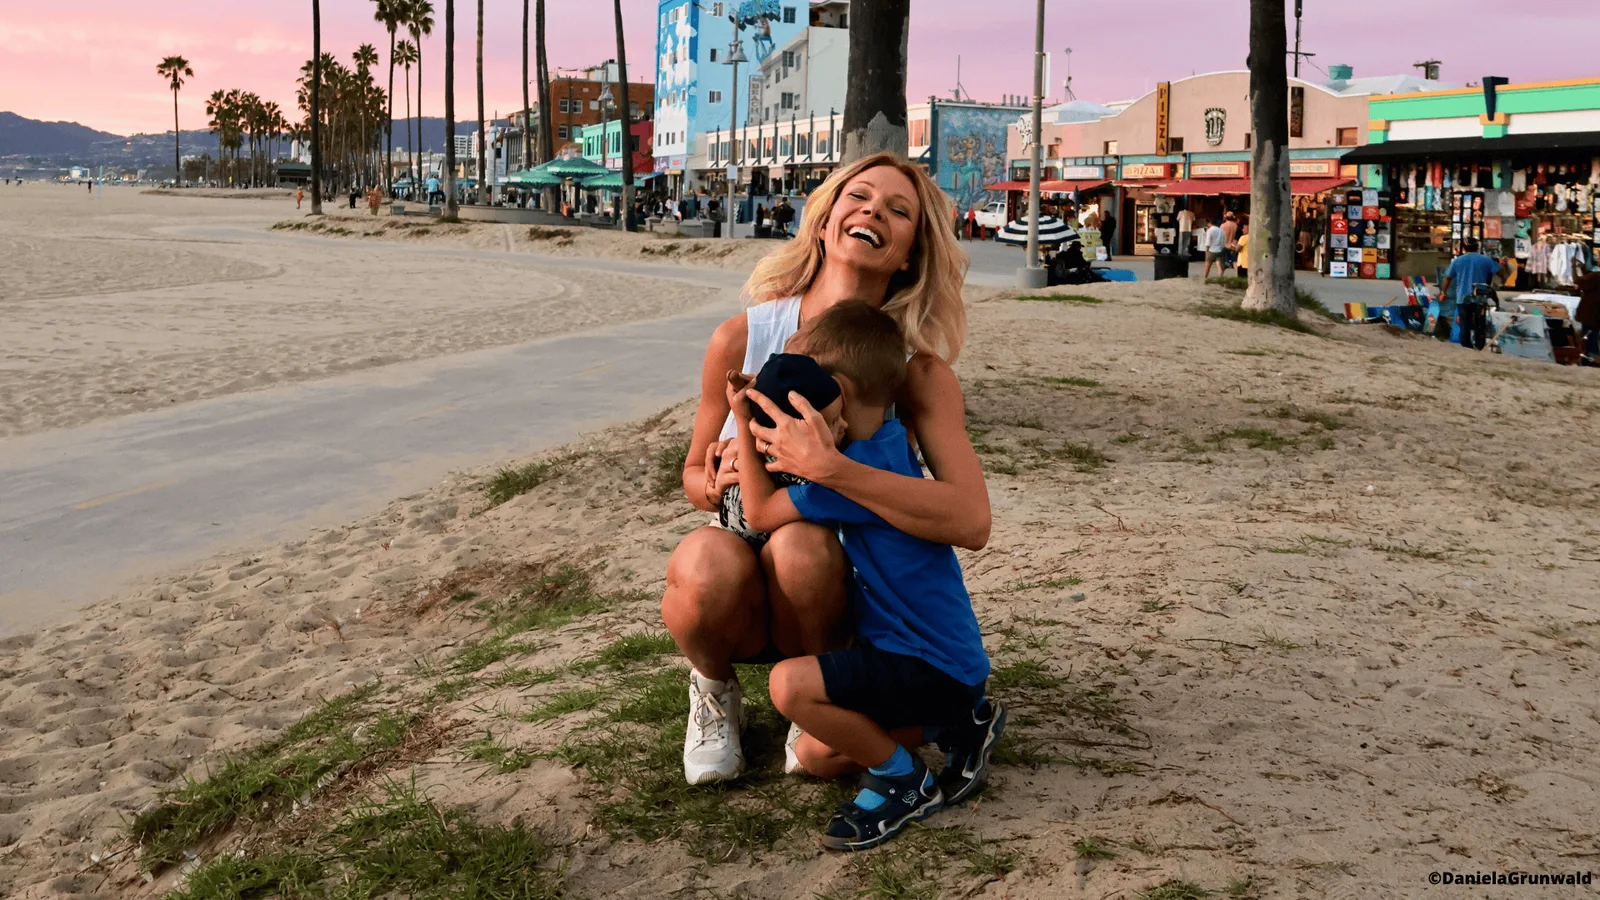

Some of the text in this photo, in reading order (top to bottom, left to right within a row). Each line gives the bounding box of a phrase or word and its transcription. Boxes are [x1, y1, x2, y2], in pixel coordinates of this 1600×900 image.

[751, 83, 760, 114] BEACH
[1133, 167, 1155, 175] PIZZA
[1517, 239, 1525, 251] LA
